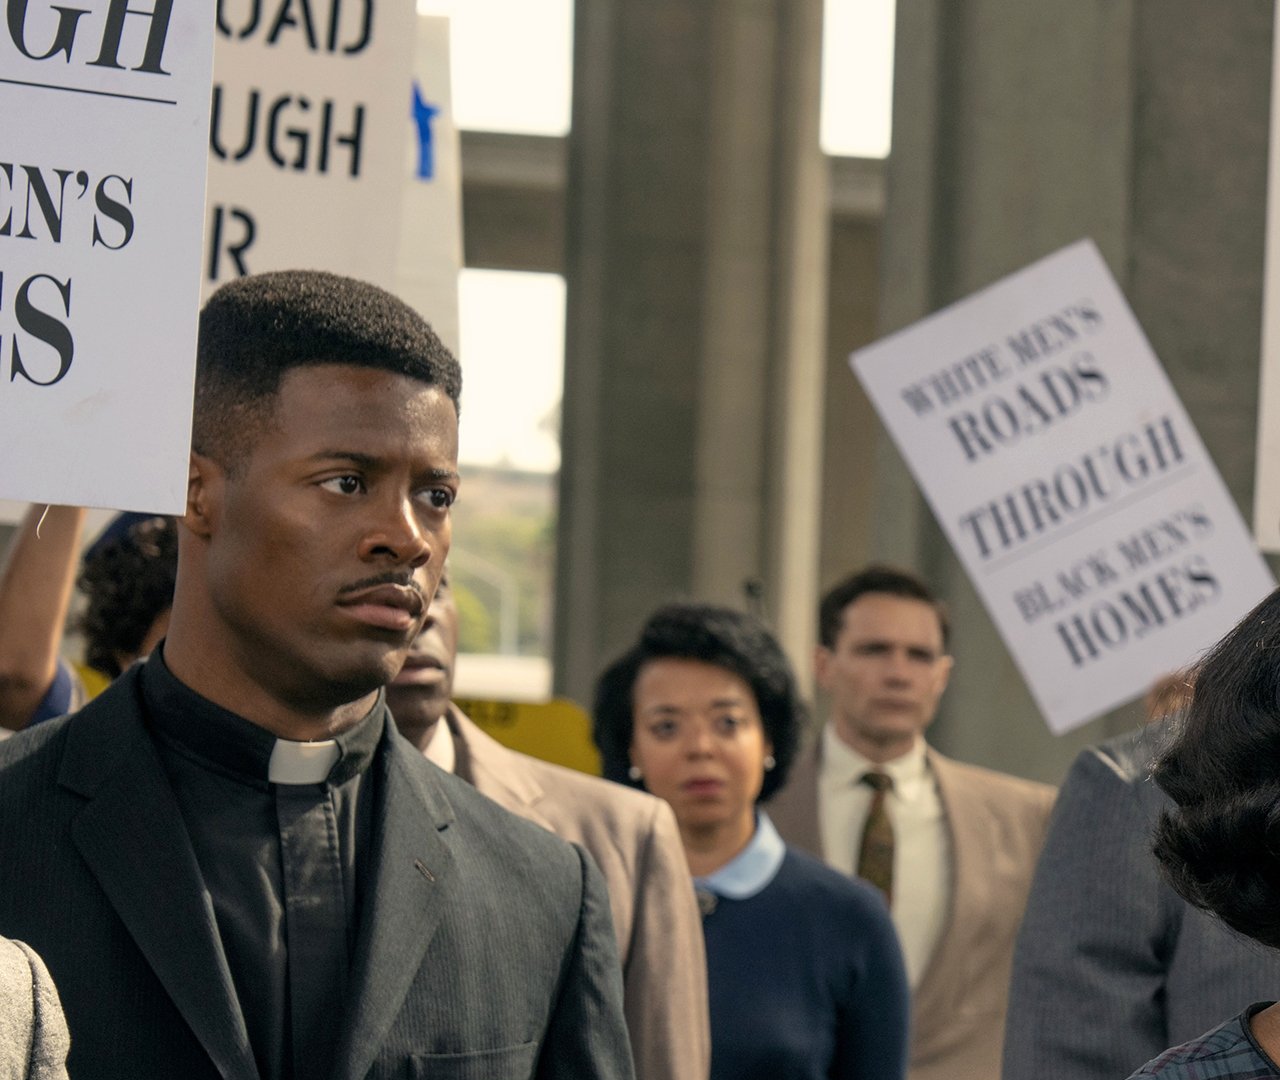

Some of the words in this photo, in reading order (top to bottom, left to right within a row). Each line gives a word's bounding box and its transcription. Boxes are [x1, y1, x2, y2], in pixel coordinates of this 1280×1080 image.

[210, 83, 366, 179] UGH
[207, 205, 257, 281] R
[0, 271, 74, 386] S
[902, 350, 1012, 417] WHITE
[1006, 301, 1104, 369] MEN'S
[947, 356, 1110, 463] ROADS
[959, 415, 1187, 561] THROUGH
[1013, 549, 1122, 625] BLACK
[1118, 506, 1214, 568] MEN'S
[1055, 556, 1222, 668] HOMES
